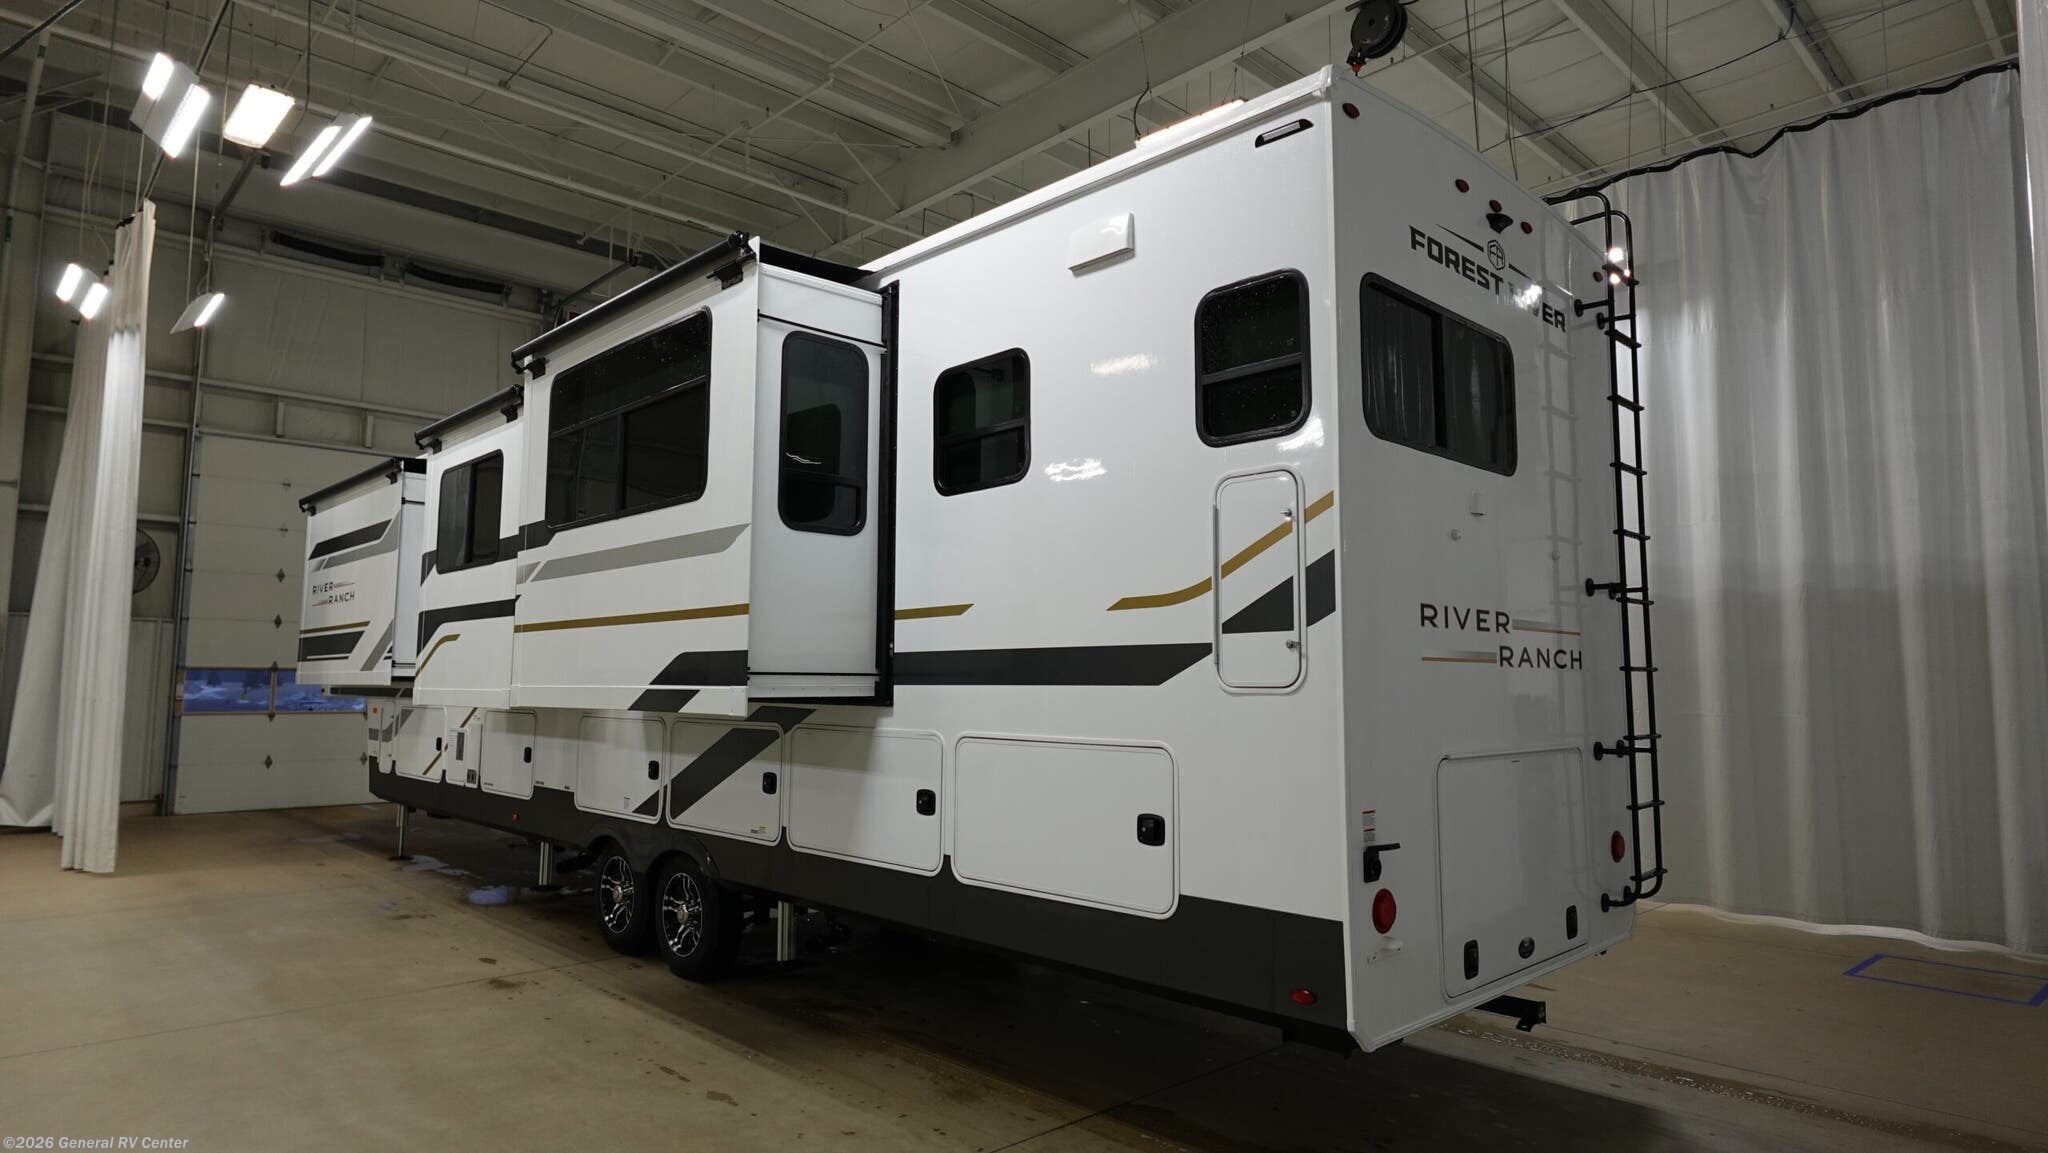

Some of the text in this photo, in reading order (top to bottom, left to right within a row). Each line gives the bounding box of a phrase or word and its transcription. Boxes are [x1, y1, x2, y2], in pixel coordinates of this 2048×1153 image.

[1408, 225, 1504, 296] FOREST
[312, 582, 334, 594] RIVER
[328, 591, 355, 604] RANCH
[1420, 603, 1511, 633] RIVER
[1499, 645, 1583, 670] RANCH
